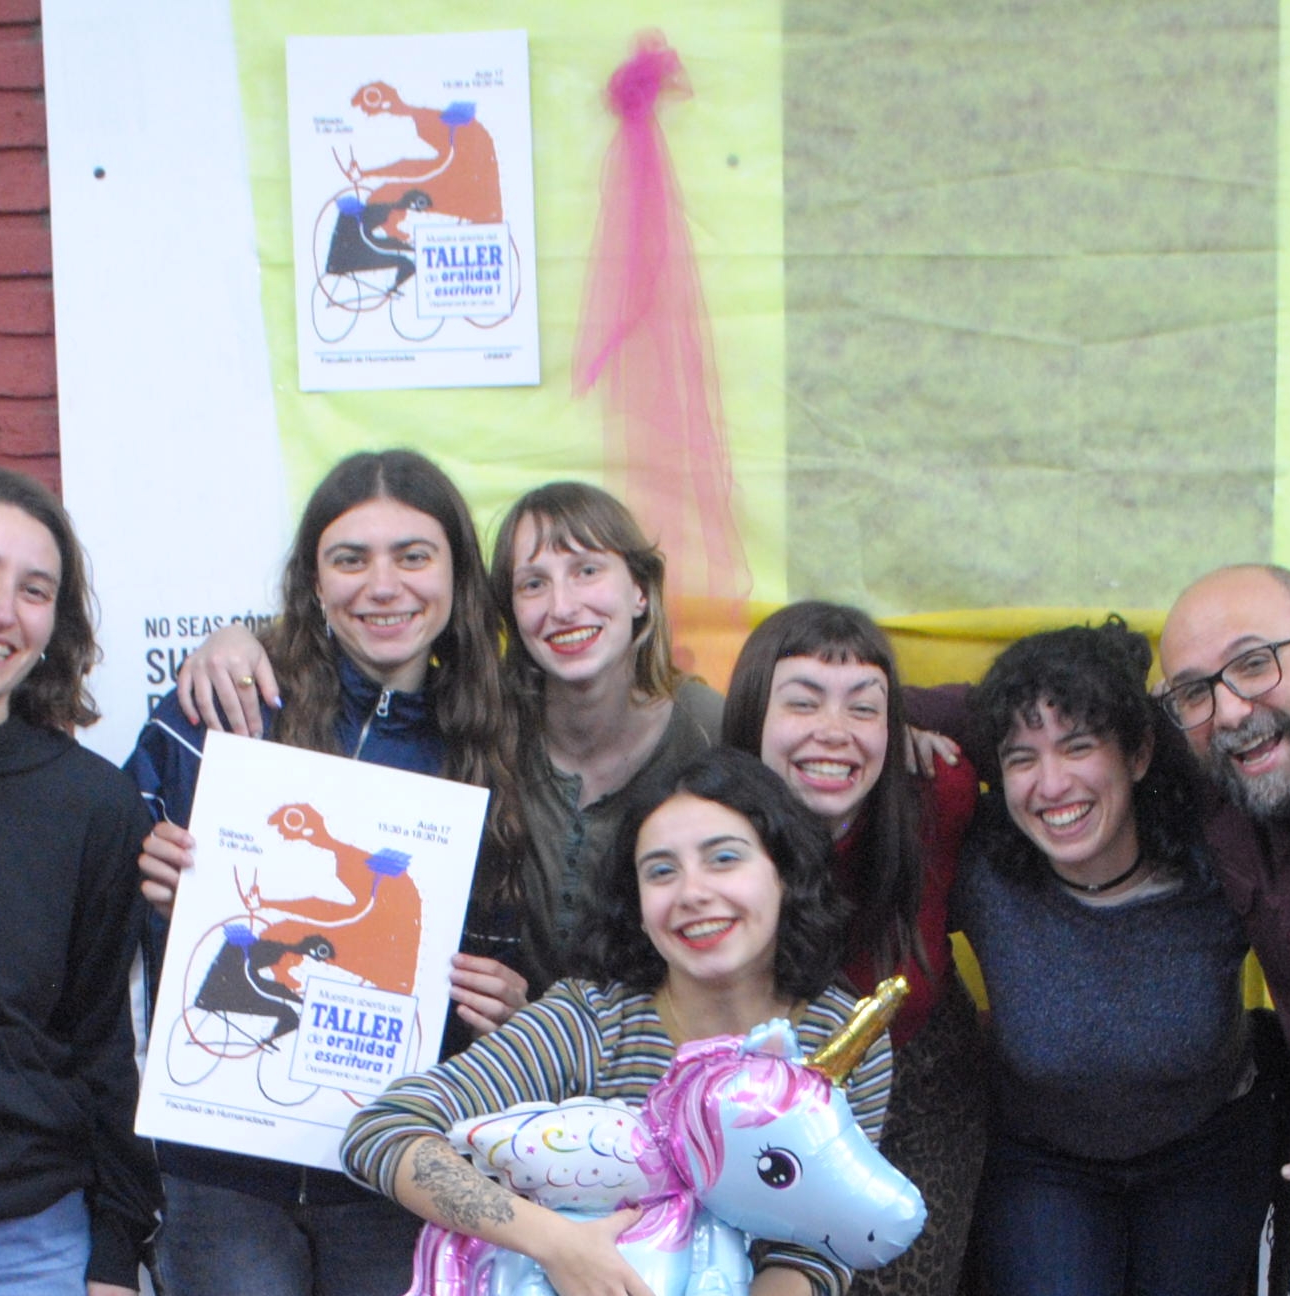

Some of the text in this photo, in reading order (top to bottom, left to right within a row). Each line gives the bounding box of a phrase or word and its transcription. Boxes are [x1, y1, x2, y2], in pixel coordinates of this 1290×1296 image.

[422, 244, 504, 269] TALLER
[441, 267, 501, 283] oralidad
[434, 283, 493, 297] escritura
[145, 617, 171, 638] NO
[177, 615, 224, 637] SEAS
[417, 820, 451, 834] Aula 17
[227, 839, 239, 850] de
[311, 1001, 404, 1044] TALLER
[307, 1032, 397, 1059] de oralidad
[314, 1049, 384, 1073] escritura
[165, 1098, 276, 1128] Facultad de Humanidades
